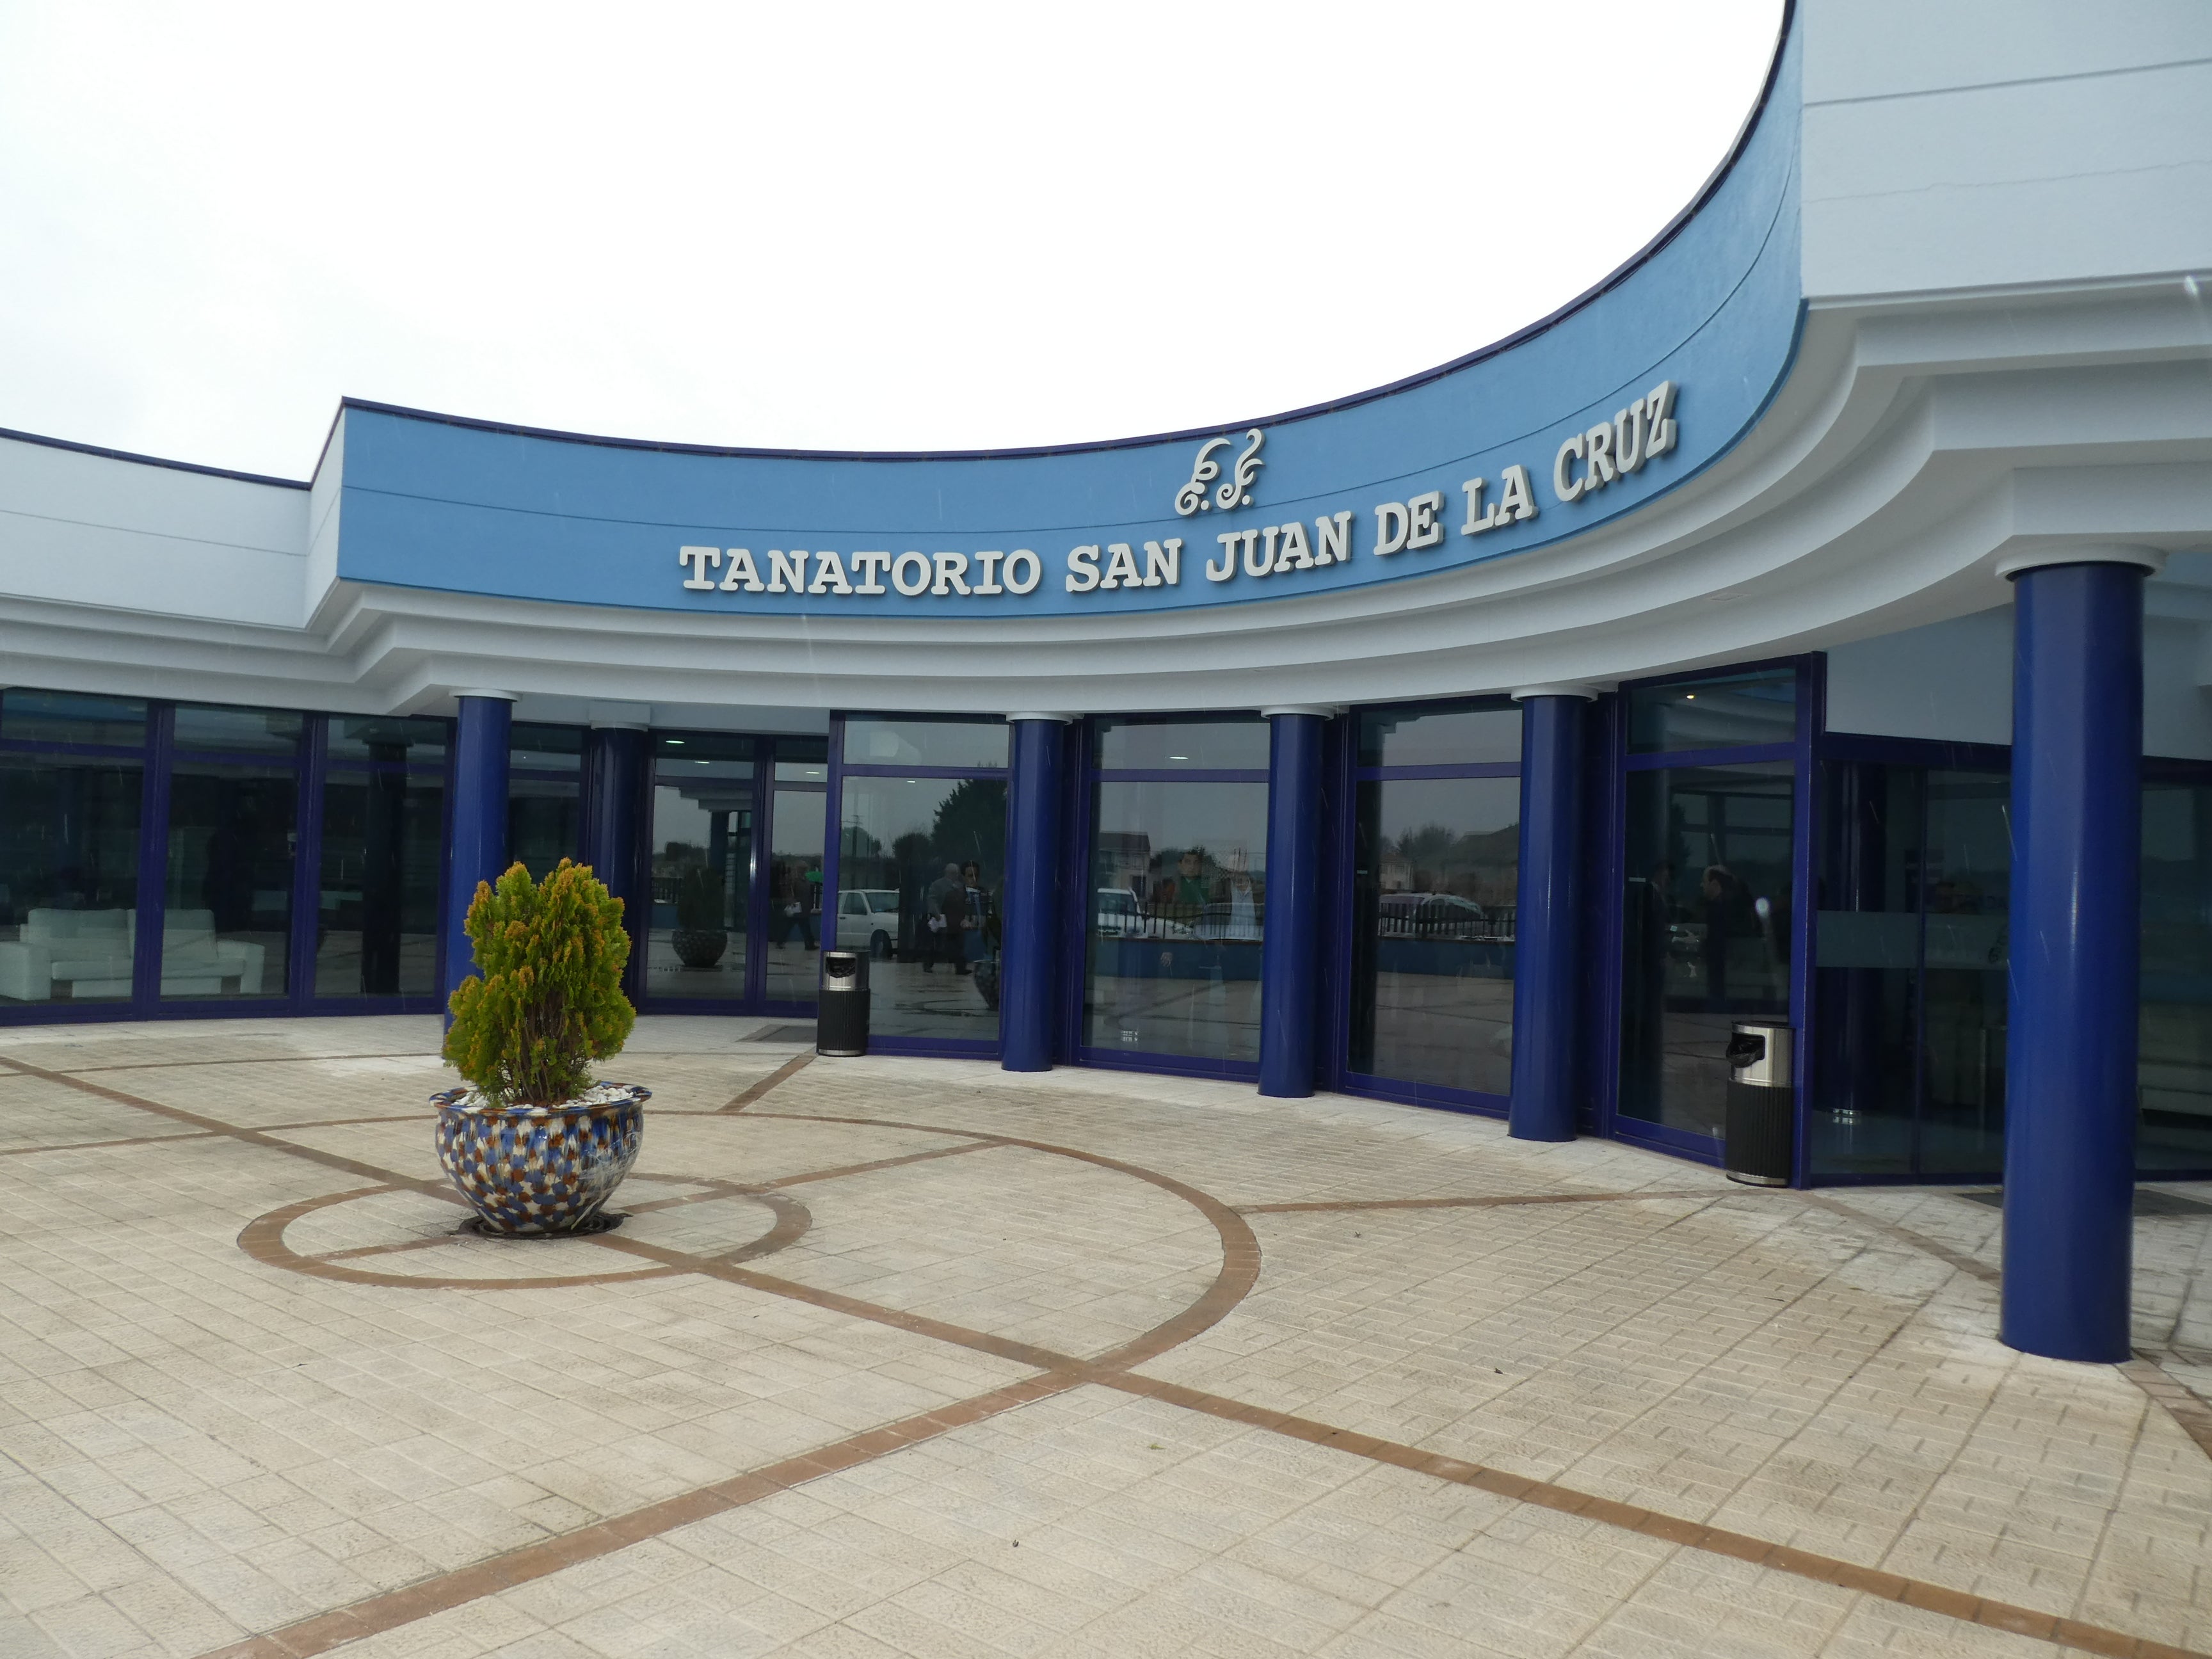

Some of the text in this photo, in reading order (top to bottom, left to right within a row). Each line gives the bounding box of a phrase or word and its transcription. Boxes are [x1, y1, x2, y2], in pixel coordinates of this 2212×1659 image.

[679, 380, 1677, 596] TANATORIO SAN JUAN DE LA CRUZ
